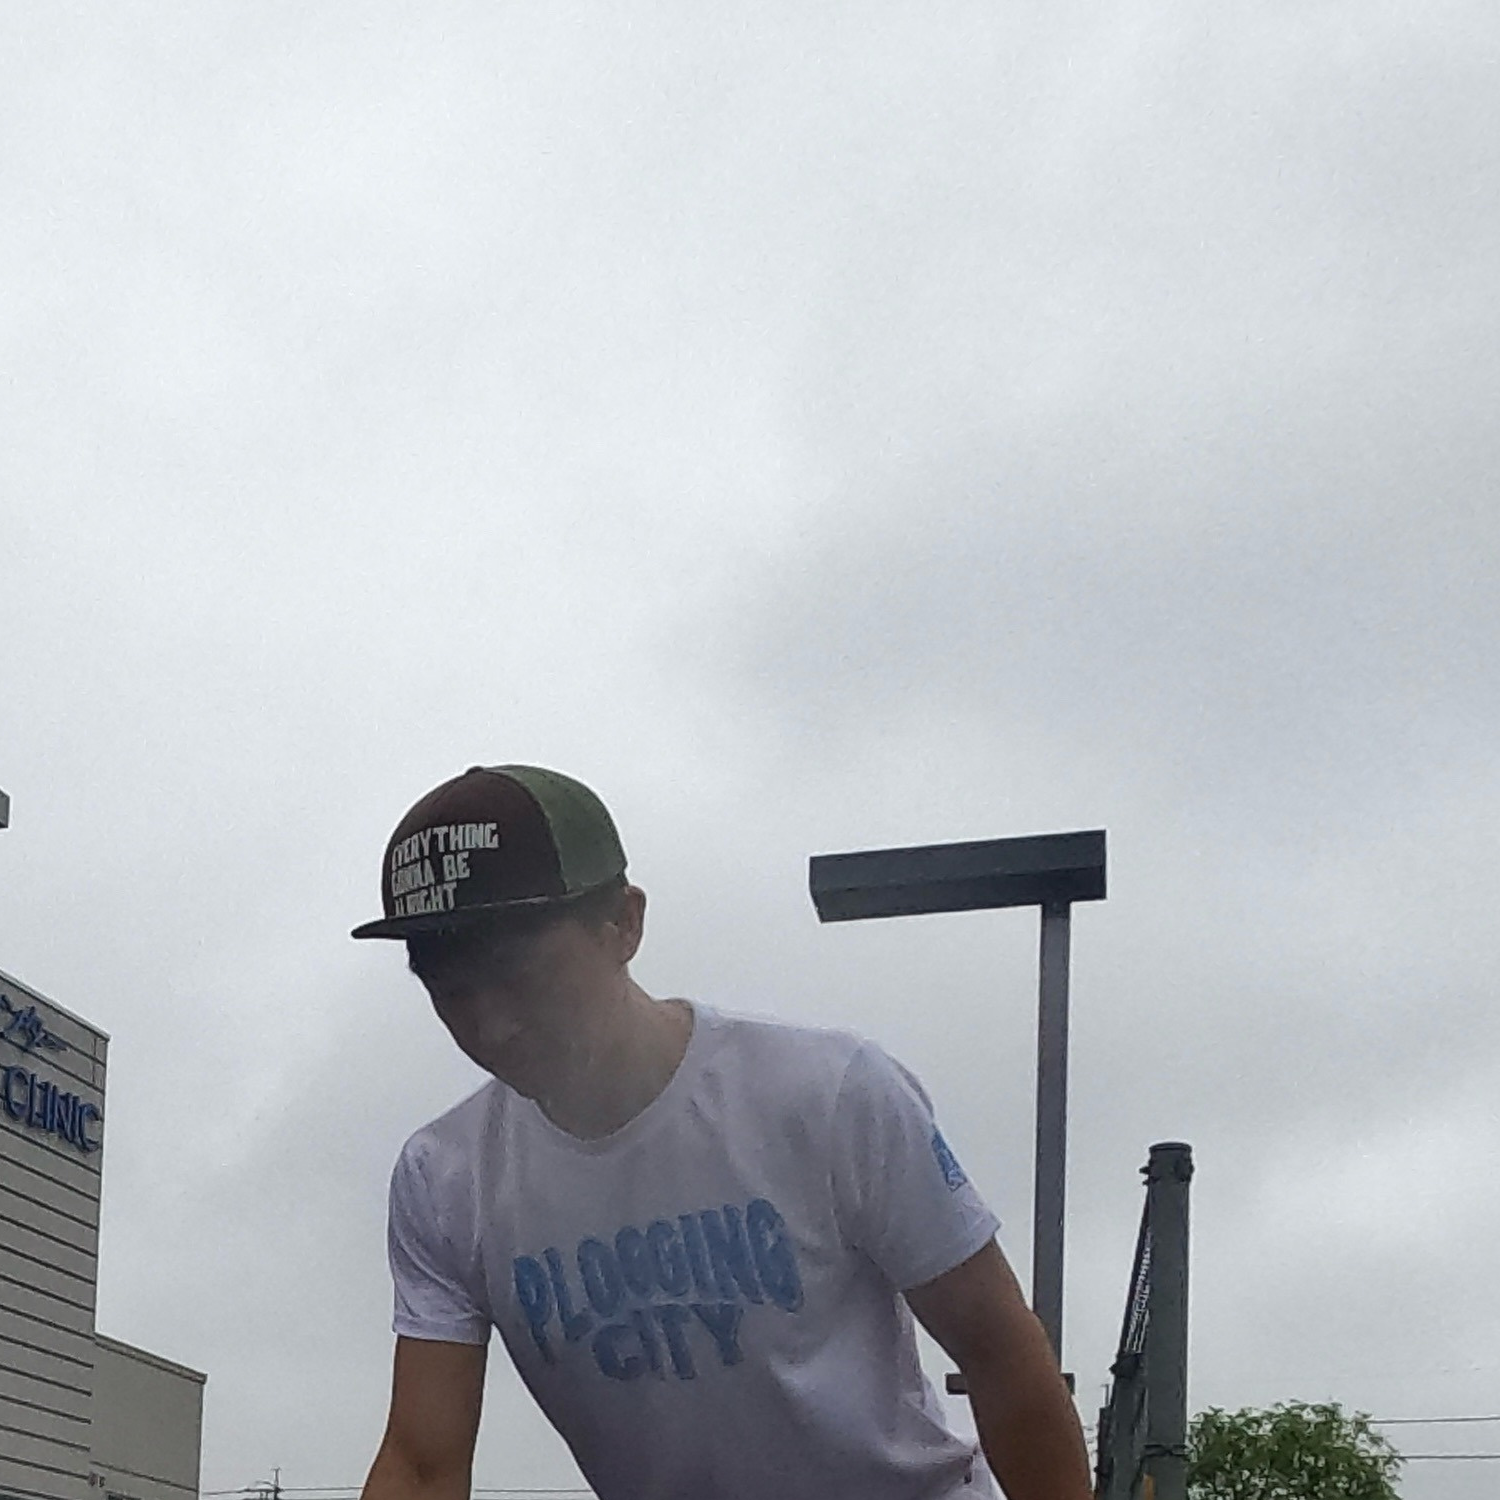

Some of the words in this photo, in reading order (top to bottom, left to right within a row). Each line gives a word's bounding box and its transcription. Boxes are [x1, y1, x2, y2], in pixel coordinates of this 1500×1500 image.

[443, 851, 471, 881] BE
[4, 1065, 100, 1153] CLINIC
[513, 1198, 803, 1364] PLOGGING
[592, 1303, 744, 1380] CITY
